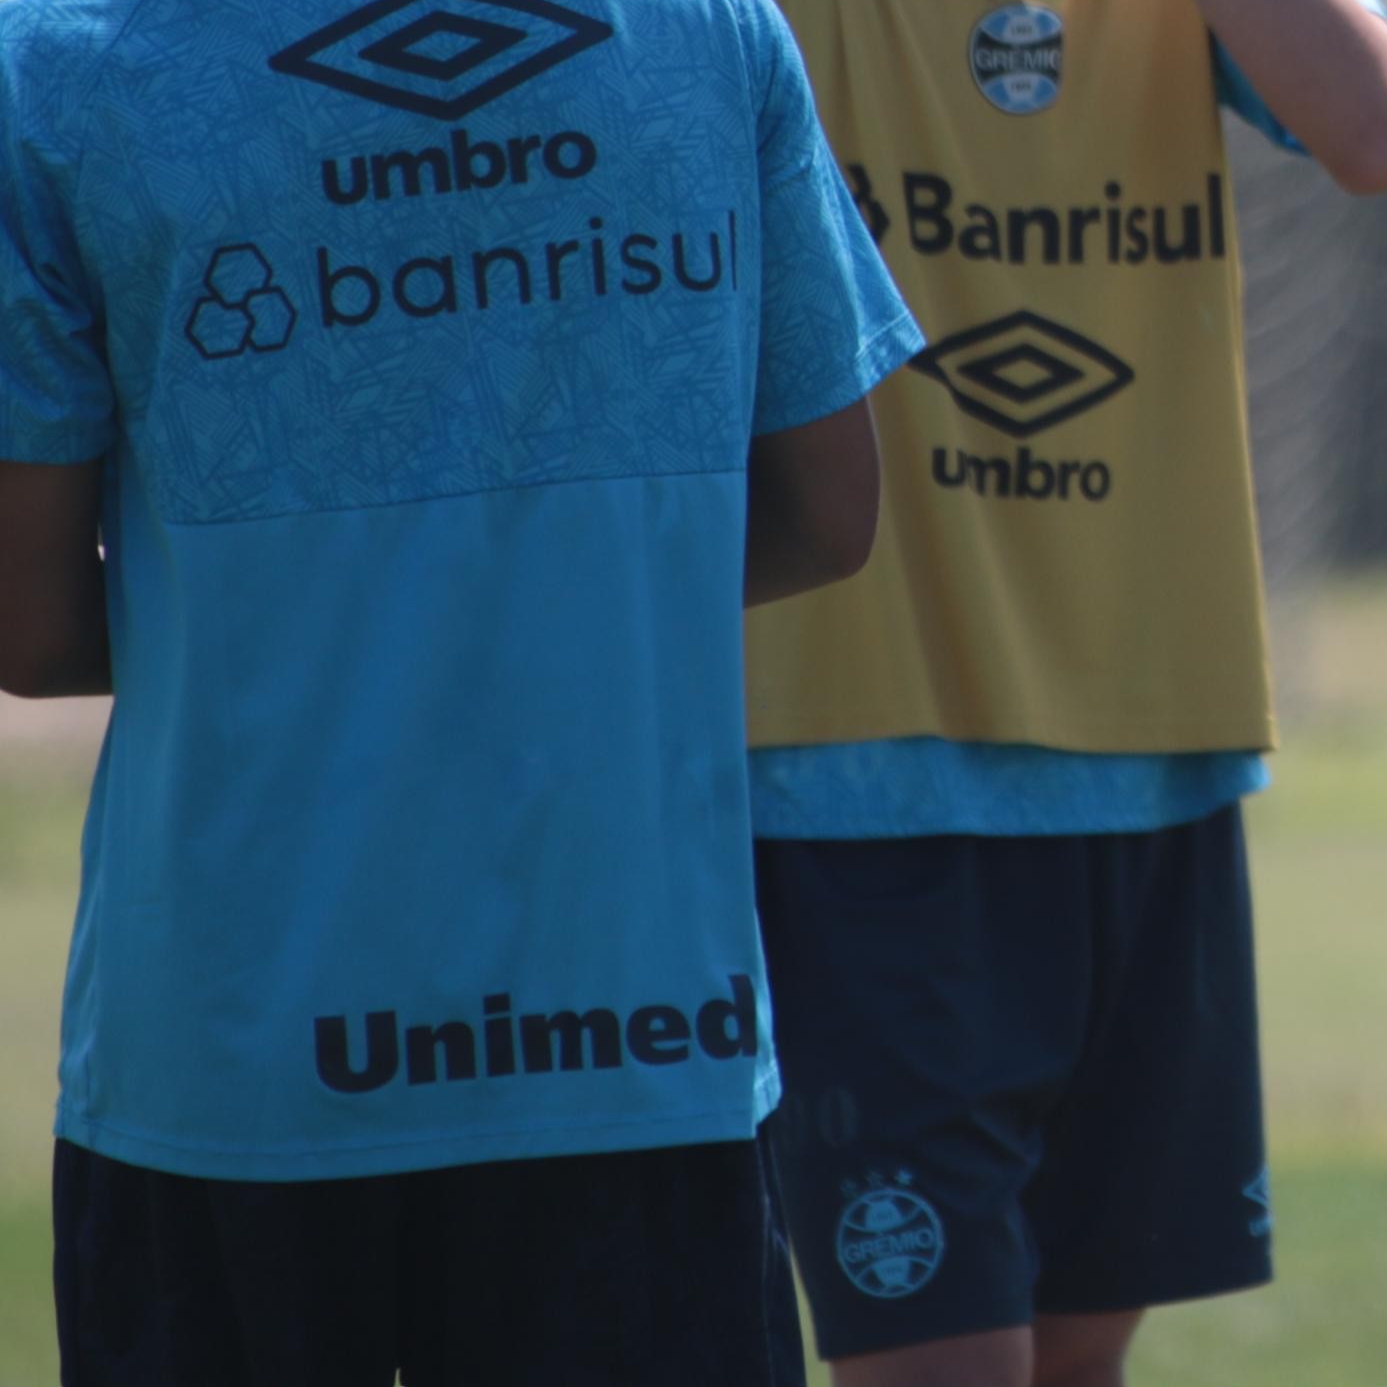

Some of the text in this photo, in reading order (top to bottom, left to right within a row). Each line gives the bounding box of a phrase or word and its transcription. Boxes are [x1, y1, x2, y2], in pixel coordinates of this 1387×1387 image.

[321, 129, 598, 205] umbro
[902, 170, 1226, 267] Banrisul
[317, 210, 738, 328] banrisul
[931, 446, 1110, 503] umbro
[313, 974, 759, 1094] Unimed
